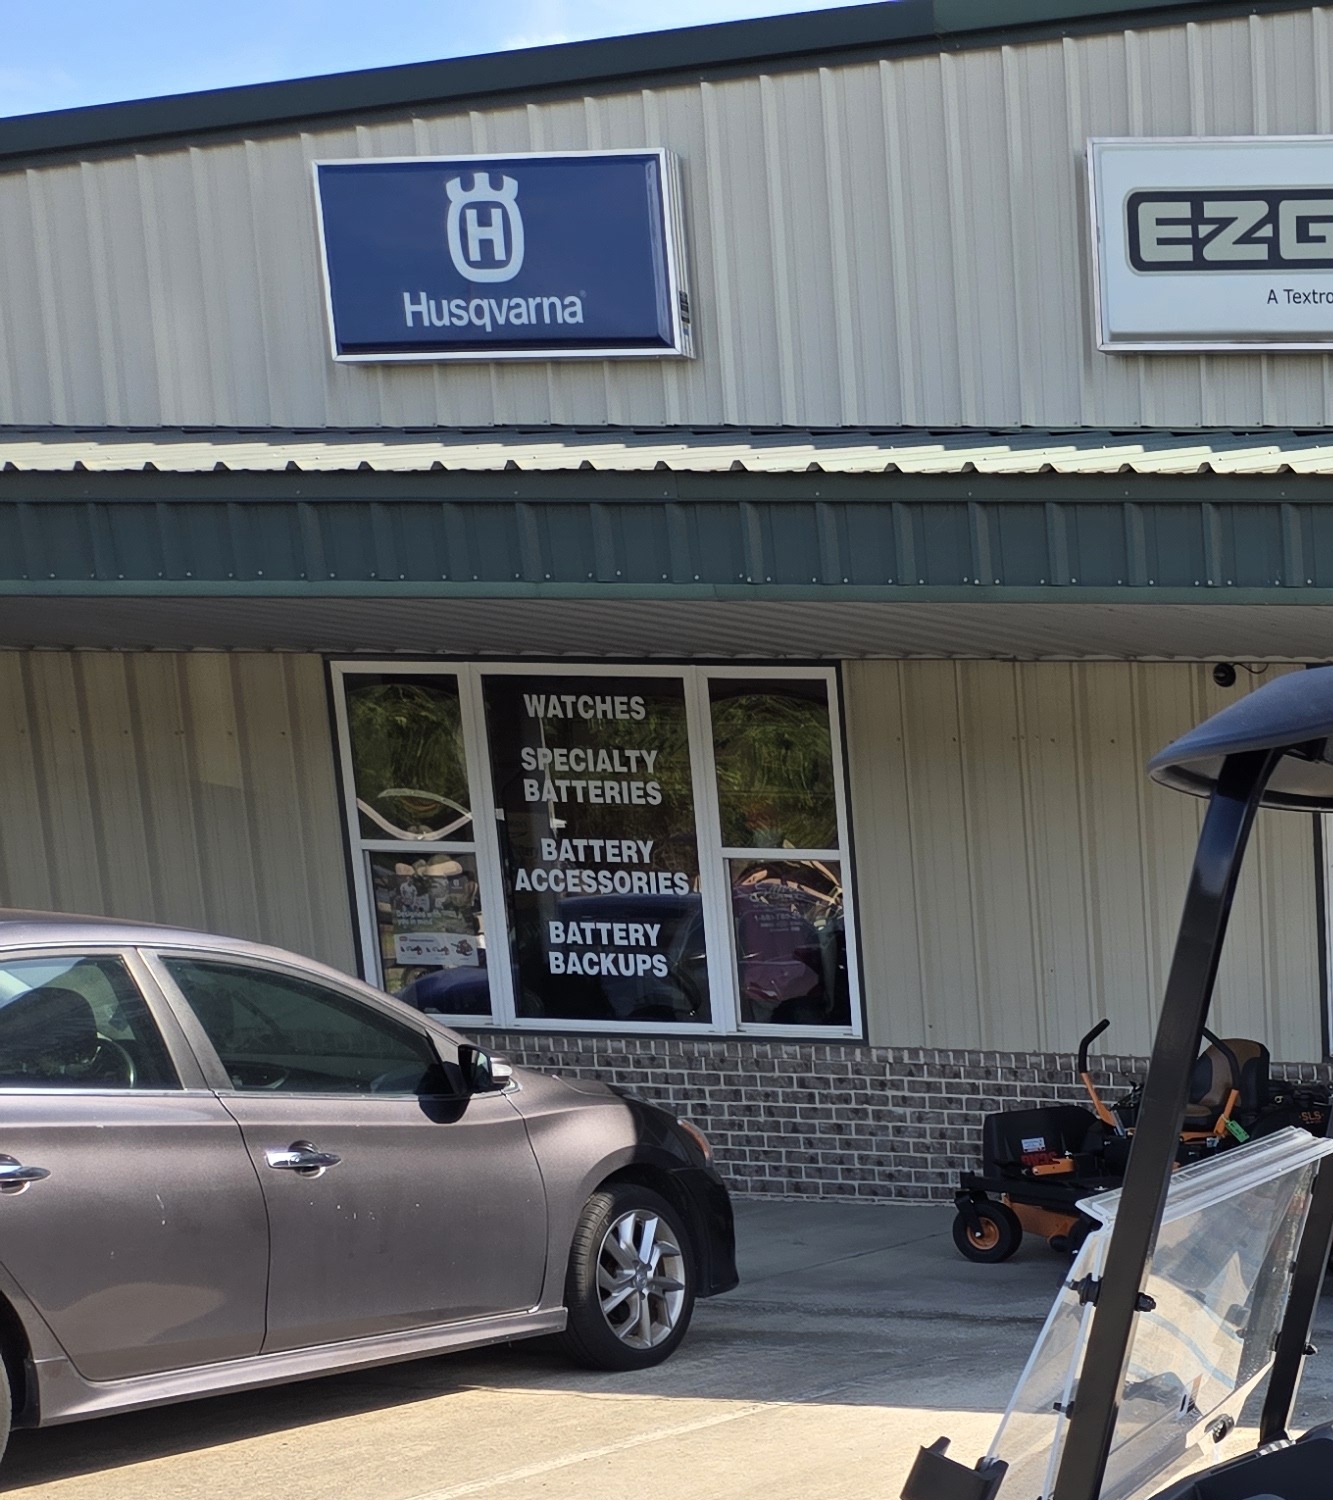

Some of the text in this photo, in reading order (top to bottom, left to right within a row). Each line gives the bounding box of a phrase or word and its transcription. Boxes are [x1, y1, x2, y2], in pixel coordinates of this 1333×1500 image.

[1267, 289, 1278, 304] A
[403, 290, 584, 332] Husqvarna
[523, 693, 645, 720] WATCHES
[521, 747, 658, 773] SPECIALTY
[524, 779, 662, 806] BATTERIES
[541, 838, 654, 863] BATTERY
[515, 868, 691, 895] ACCESSORIES
[549, 921, 661, 947] BATTERY
[549, 952, 669, 978] BACKUPS
